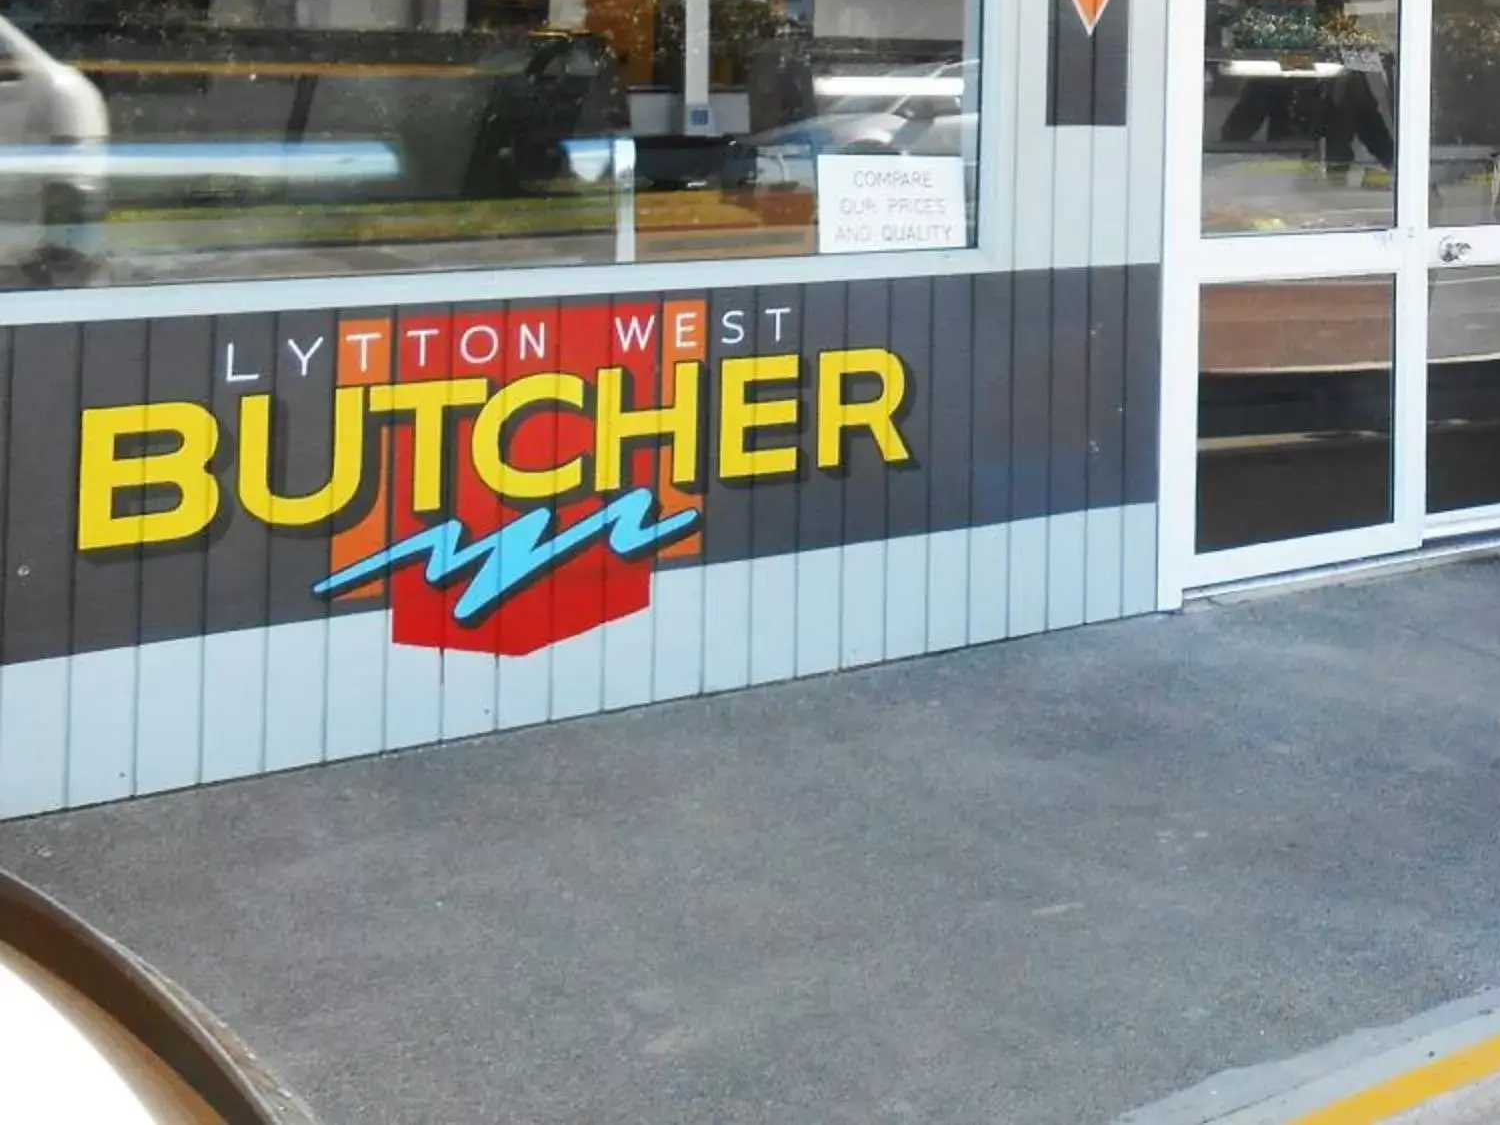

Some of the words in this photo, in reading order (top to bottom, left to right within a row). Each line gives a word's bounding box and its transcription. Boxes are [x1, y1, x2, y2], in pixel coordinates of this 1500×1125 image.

[853, 169, 934, 188] COMPARE
[834, 224, 872, 243] AND
[881, 223, 953, 243] QUALITY
[226, 320, 546, 383] LYTTON
[614, 306, 793, 352] WEST
[78, 347, 914, 552] BUTCHER
